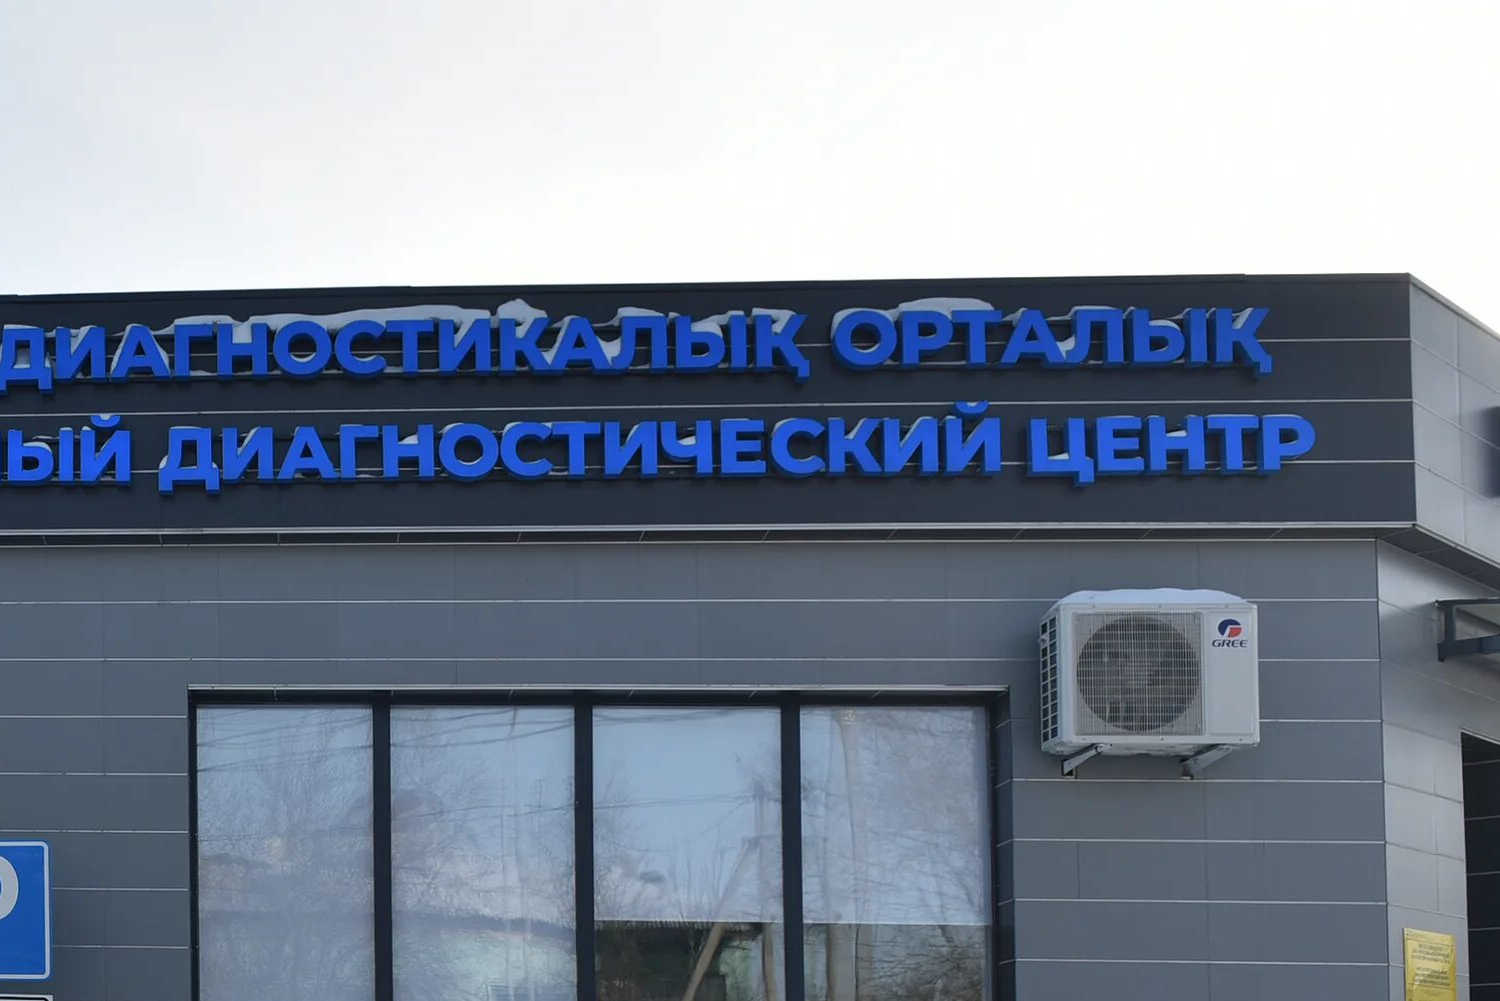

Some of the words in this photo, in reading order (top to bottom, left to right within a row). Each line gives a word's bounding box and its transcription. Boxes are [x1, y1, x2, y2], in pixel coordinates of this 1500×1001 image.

[831, 308, 1272, 374] ОРТАЛЫҚ
[159, 401, 1000, 495] ДИАГНОСТИЧЕСКИЙ
[1026, 413, 1316, 485] ЦЕНТР
[1212, 639, 1248, 648] GREE
